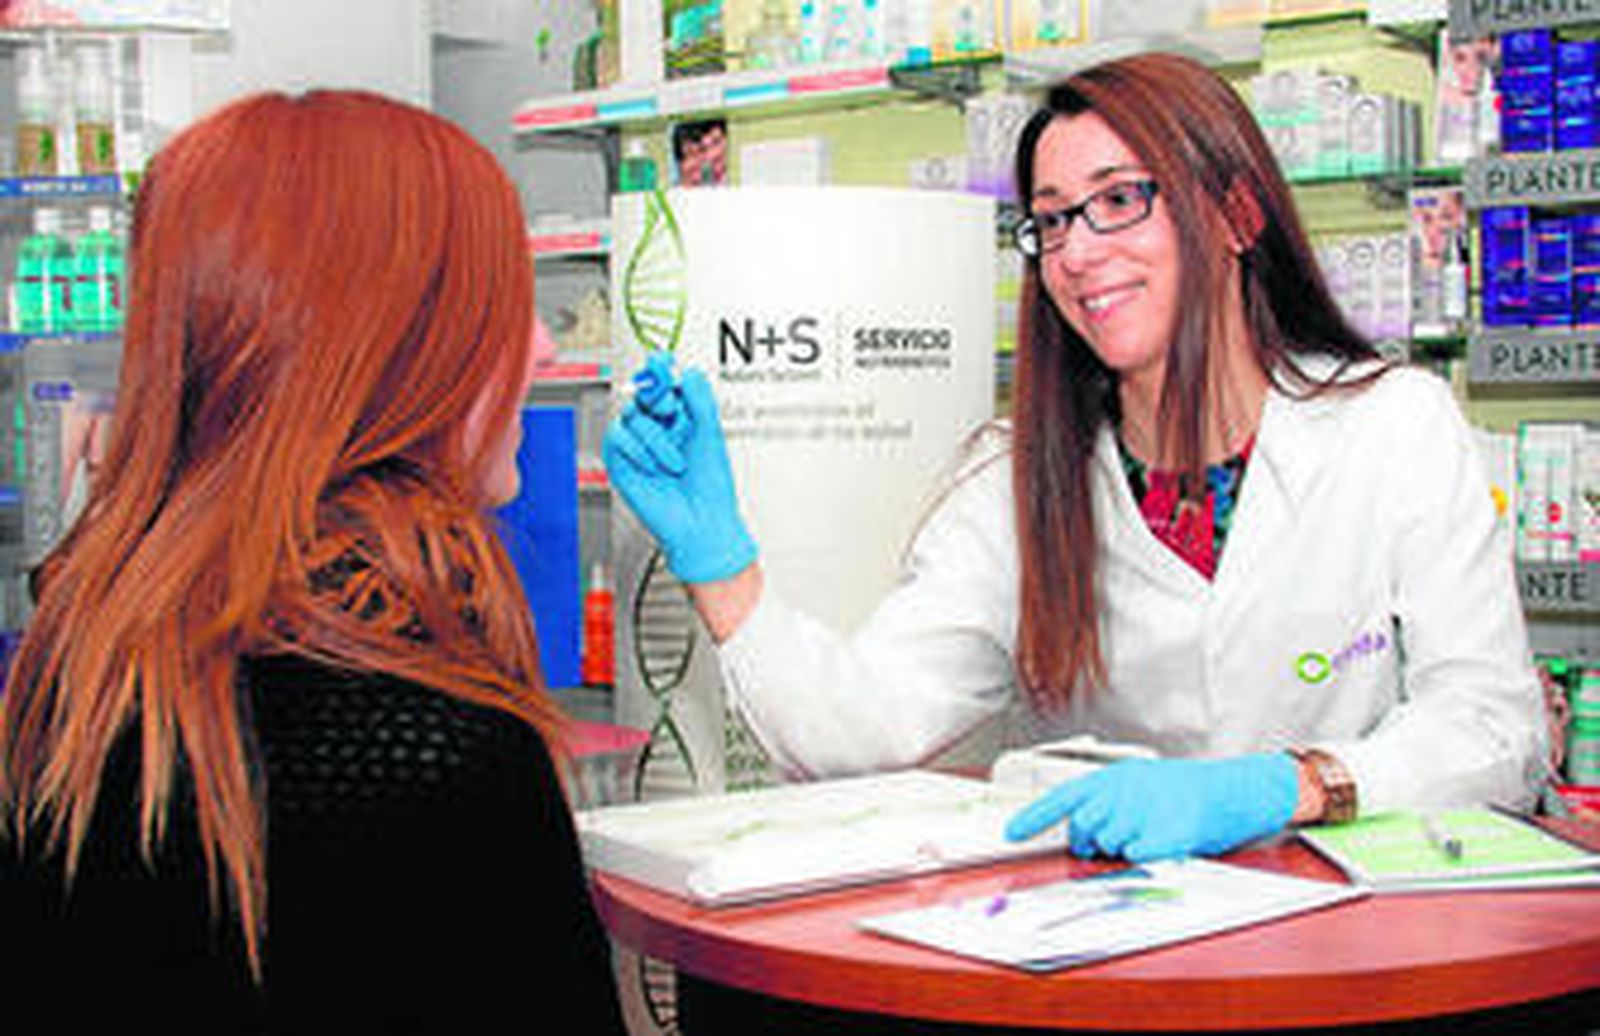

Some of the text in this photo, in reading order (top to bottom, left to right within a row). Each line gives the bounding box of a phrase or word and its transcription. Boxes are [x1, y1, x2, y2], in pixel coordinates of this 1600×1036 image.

[1487, 161, 1600, 195] PLANTE
[718, 317, 822, 366] N+S
[1526, 571, 1588, 600] NTE
